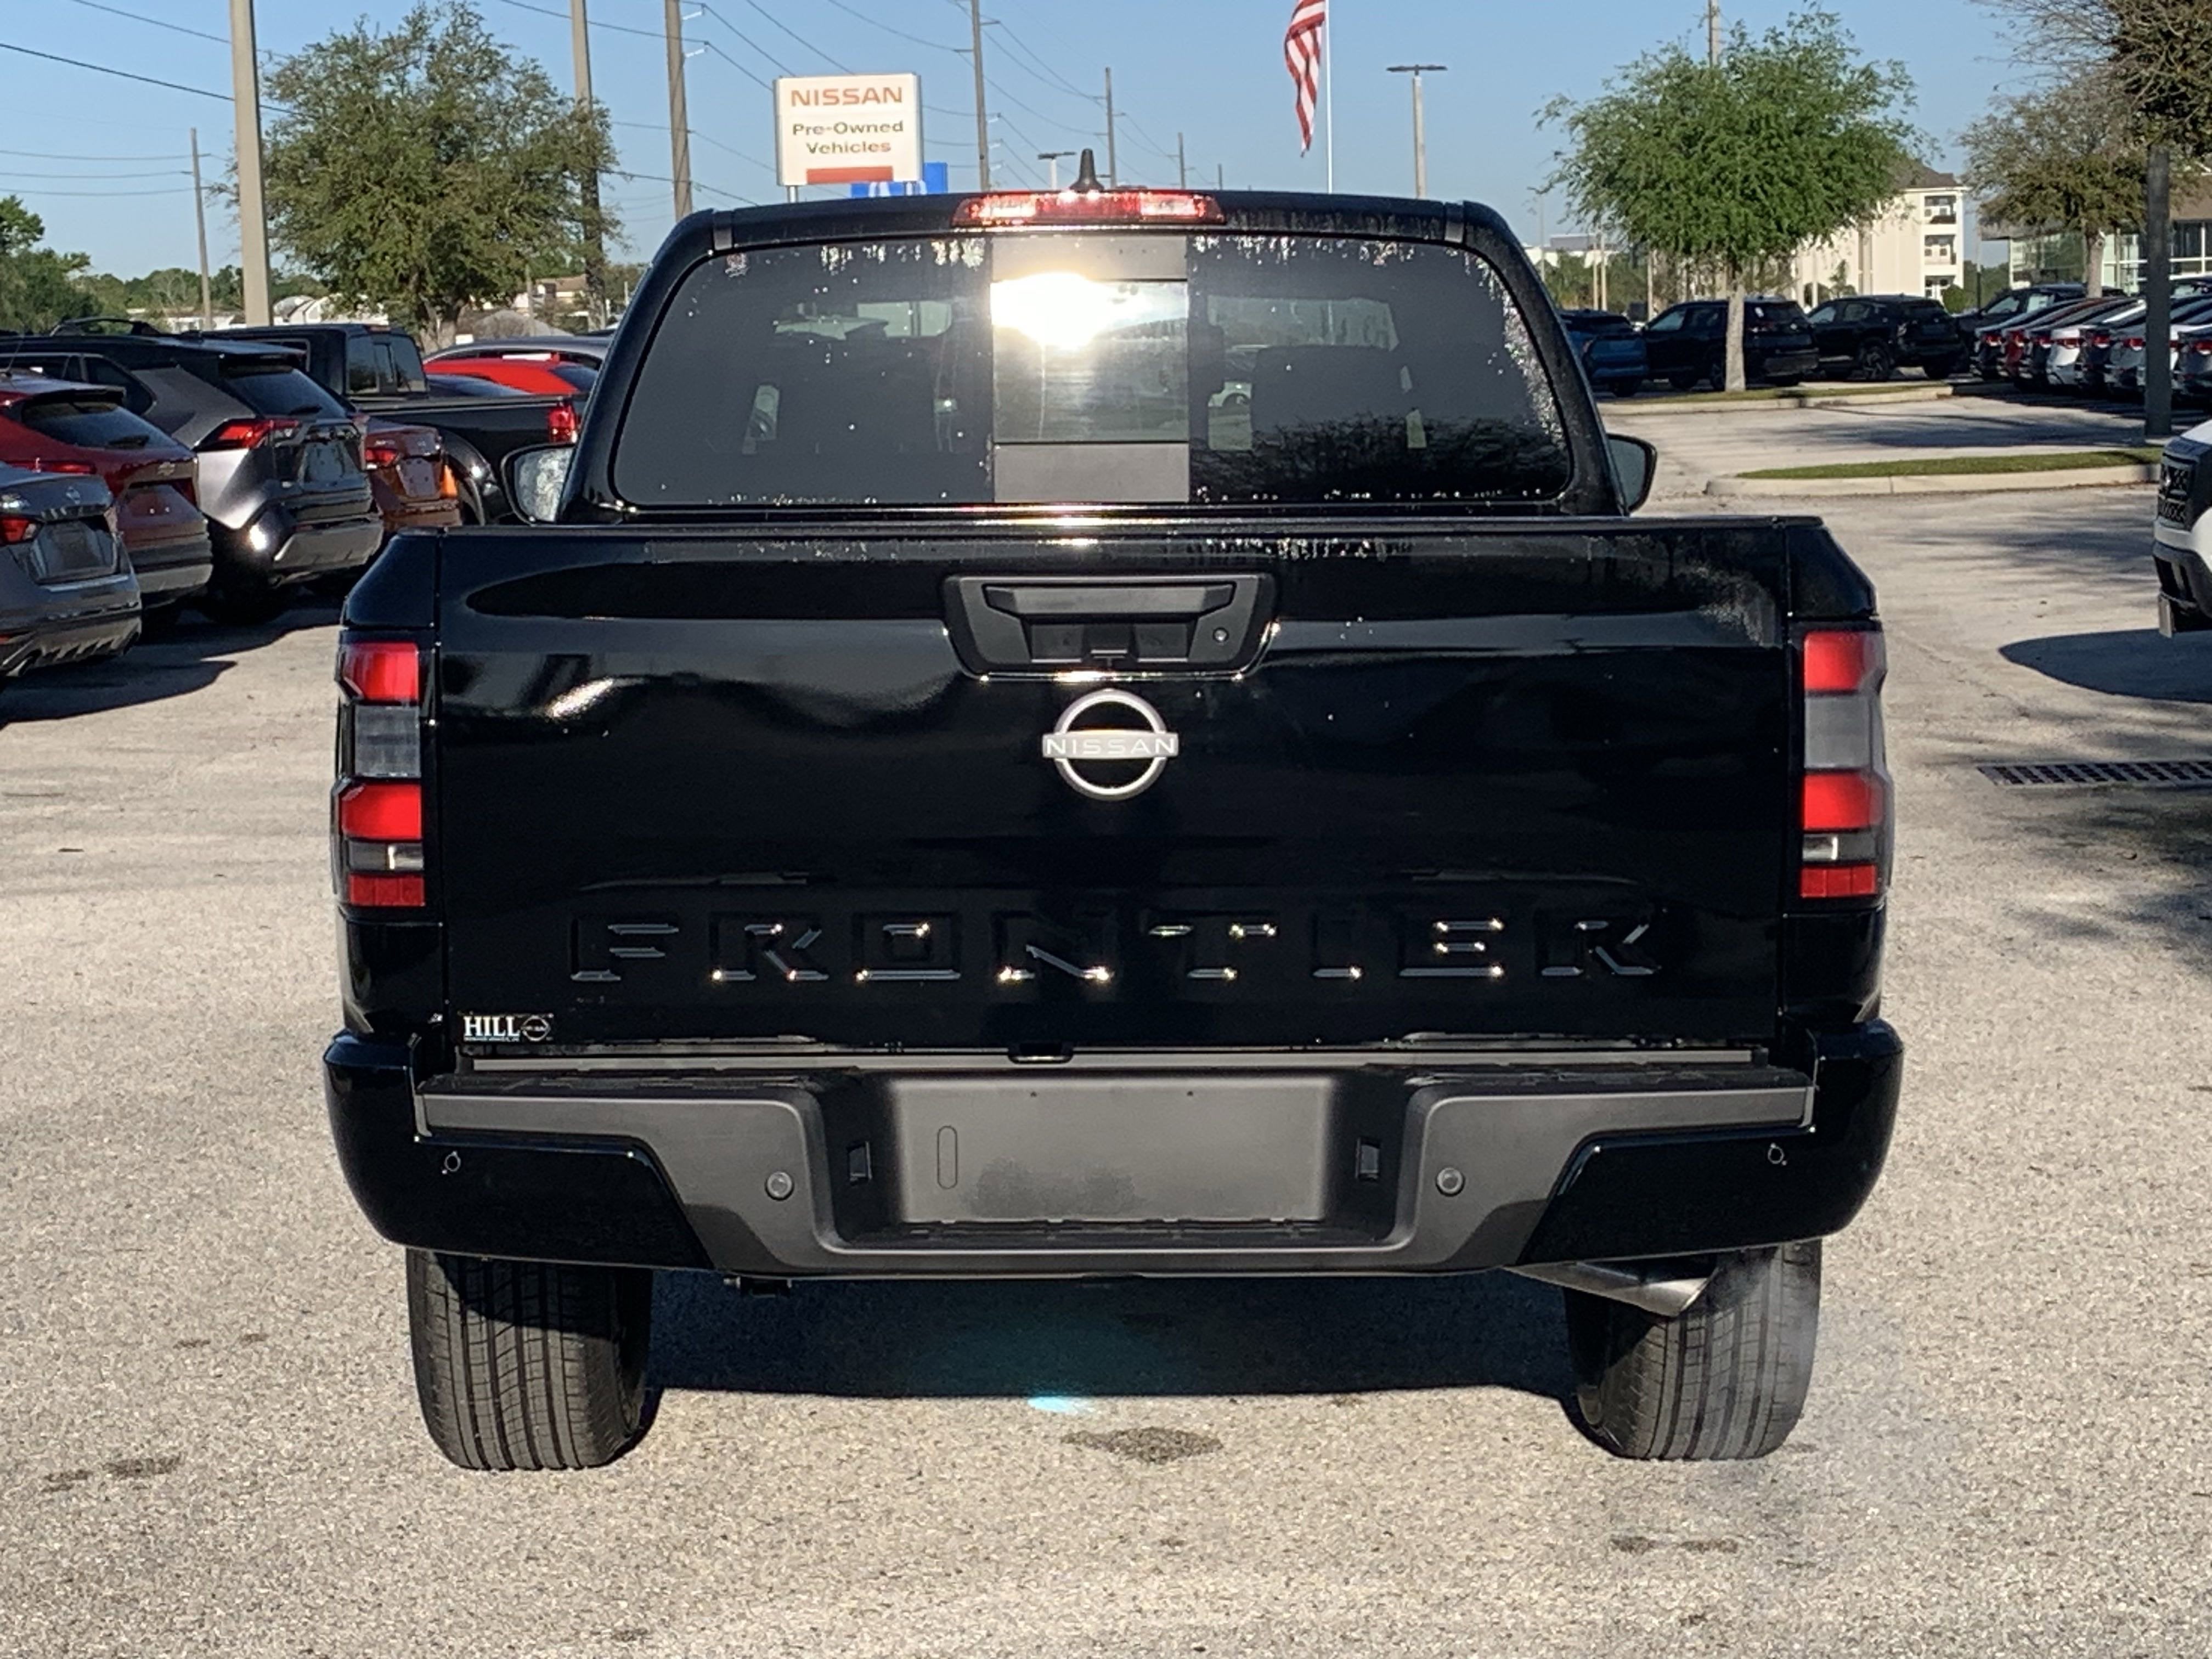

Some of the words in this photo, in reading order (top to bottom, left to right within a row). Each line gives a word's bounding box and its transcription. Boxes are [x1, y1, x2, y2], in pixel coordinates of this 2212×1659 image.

[791, 87, 902, 106] NISSAN
[792, 120, 904, 135] Pre-Owned
[806, 140, 891, 154] Vehicles
[1046, 738, 1175, 755] NISSAN
[569, 911, 1658, 981] FRONTIER
[463, 1015, 521, 1036] HILL
